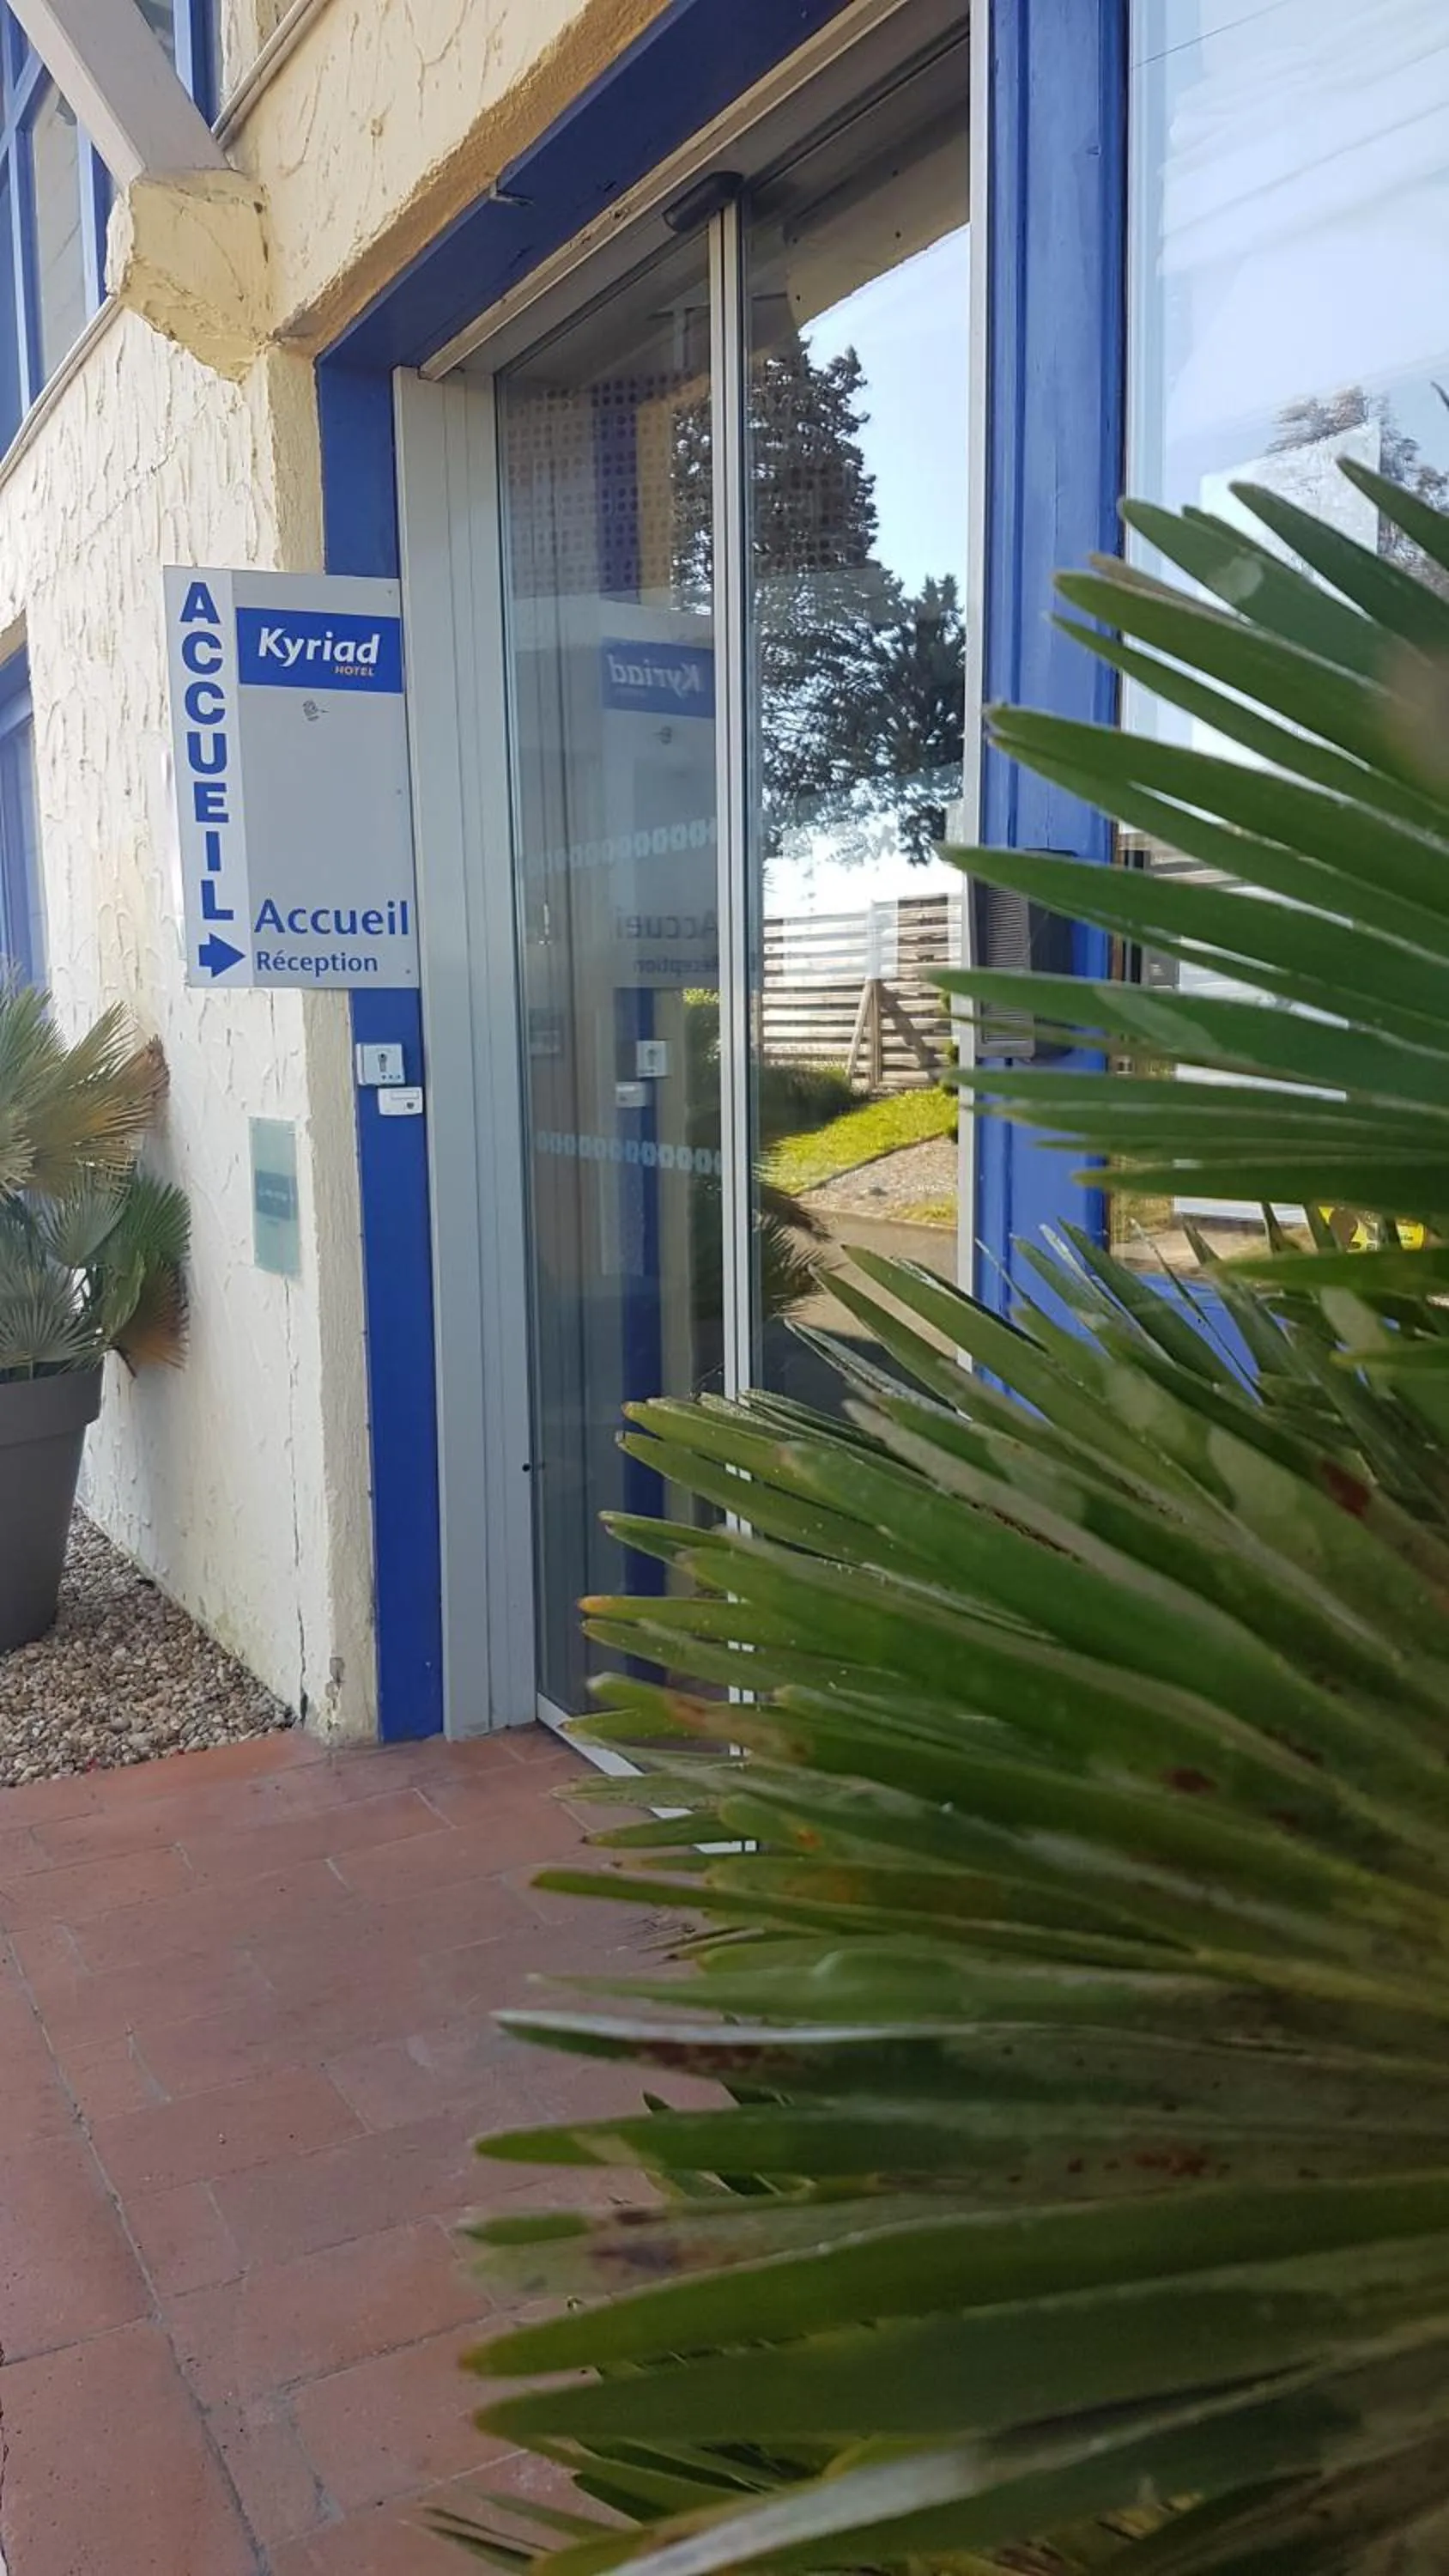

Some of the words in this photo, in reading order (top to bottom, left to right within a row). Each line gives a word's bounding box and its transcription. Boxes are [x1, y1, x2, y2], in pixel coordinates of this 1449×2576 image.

[258, 628, 380, 667] Kyriad
[335, 665, 374, 677] HOTEL
[179, 581, 234, 920] ACCUEIL
[254, 899, 409, 935] Accueil
[257, 951, 378, 977] Réception
